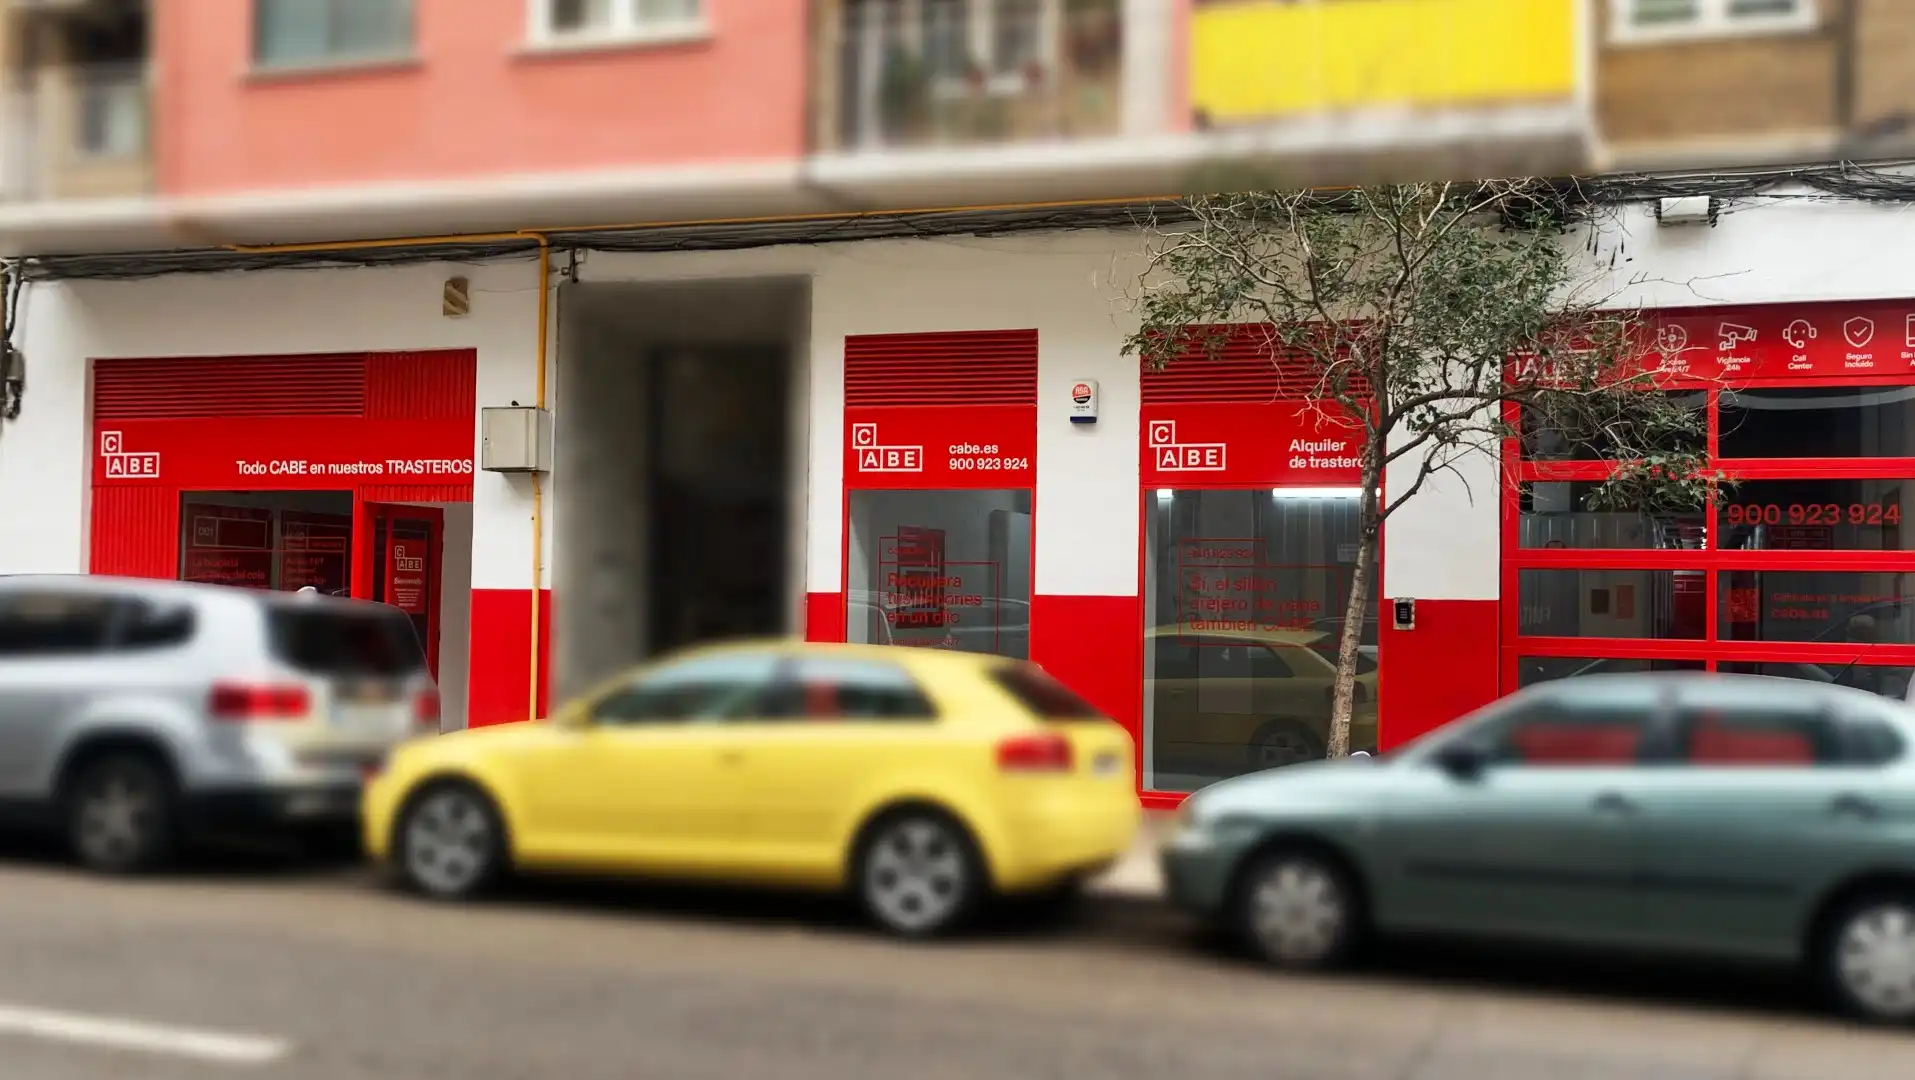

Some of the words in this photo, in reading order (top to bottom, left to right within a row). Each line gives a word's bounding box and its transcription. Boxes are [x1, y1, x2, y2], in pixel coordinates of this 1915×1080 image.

[1846, 353, 1873, 361] Seguro
[1788, 362, 1813, 370] Center
[948, 442, 999, 455] cabe.es
[1289, 439, 1346, 453] Alquiler
[236, 460, 266, 474] Todo
[269, 460, 307, 474] CABE
[309, 463, 325, 474] en
[328, 461, 383, 474] nuestros
[385, 459, 473, 474] TRASTEROS
[949, 458, 974, 470] 900
[976, 458, 1001, 470] 923
[1003, 458, 1028, 470] 924
[1289, 456, 1306, 468] de
[1309, 456, 1365, 468] trastero
[1727, 503, 1781, 525] 900
[1788, 503, 1840, 525] 923
[1848, 503, 1901, 525] 924
